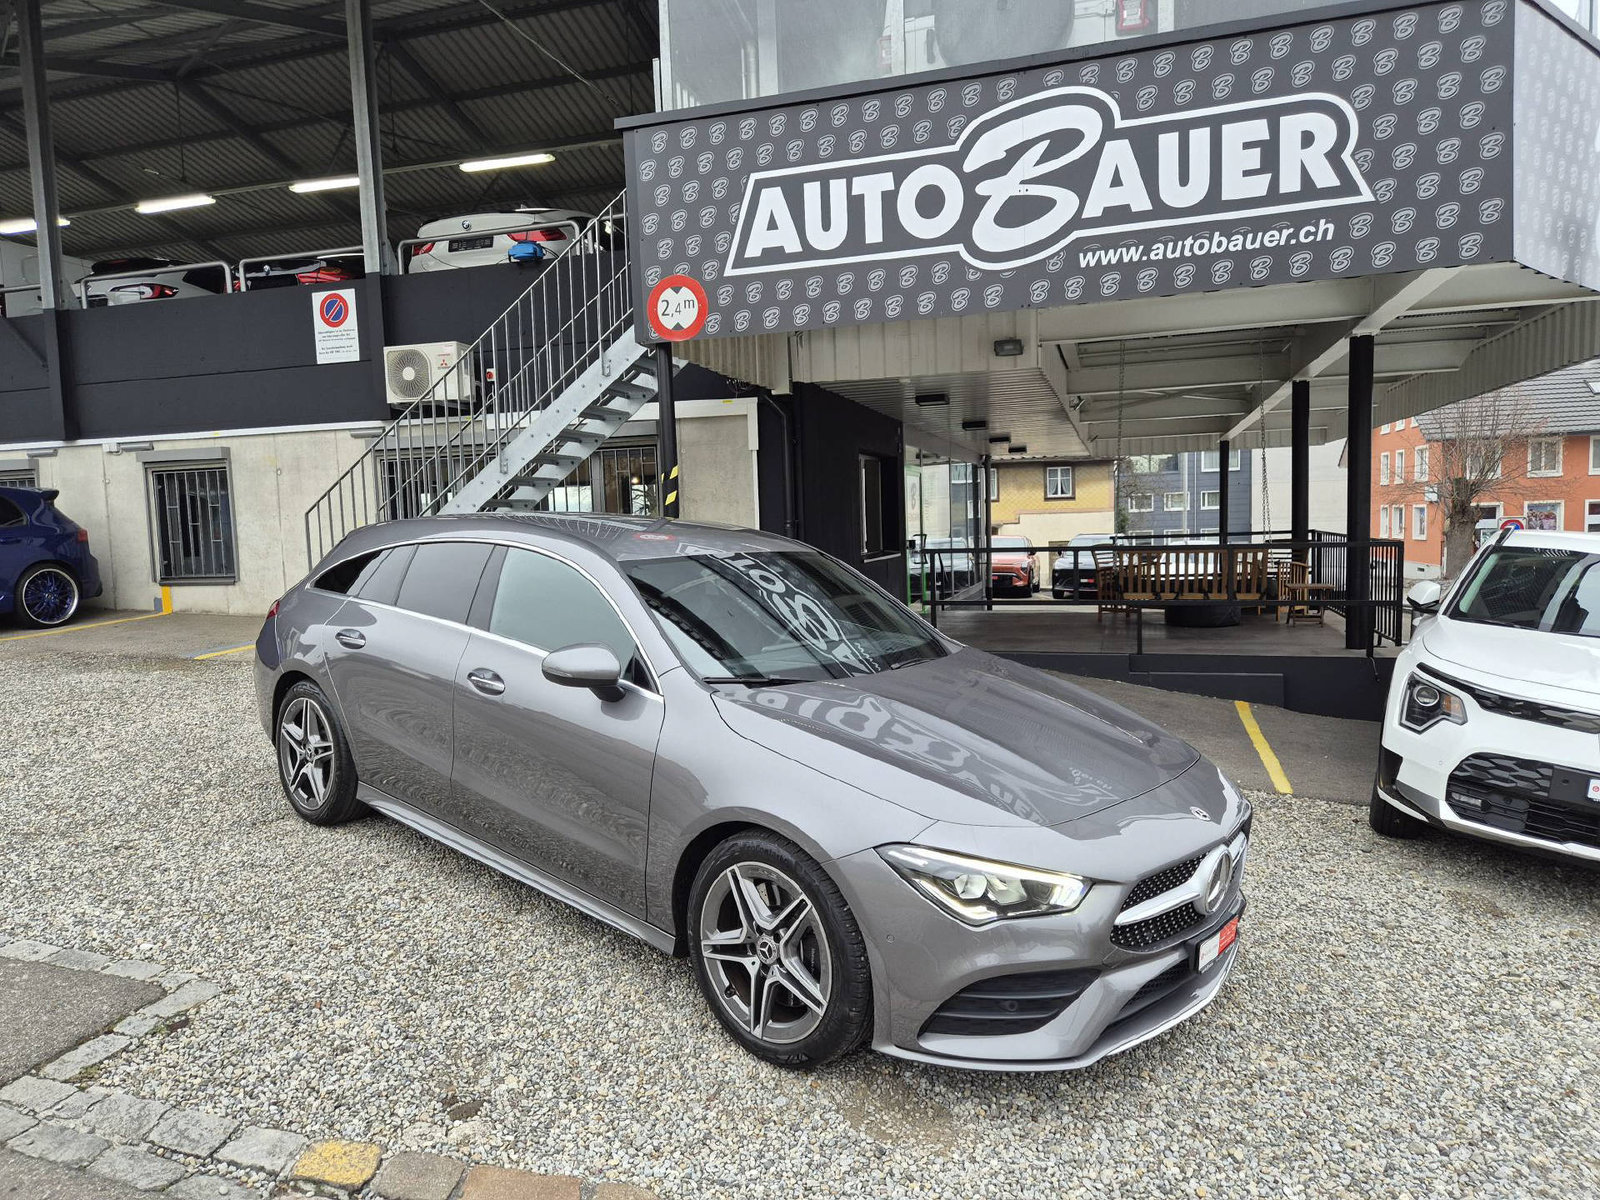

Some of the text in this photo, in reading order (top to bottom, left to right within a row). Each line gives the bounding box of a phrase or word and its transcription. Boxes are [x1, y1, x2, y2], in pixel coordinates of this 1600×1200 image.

[1393, 12, 1419, 40] B
[1437, 6, 1463, 34] B
[1480, 0, 1508, 27] B
[1308, 25, 1334, 53] B
[1351, 19, 1376, 46] B
[1191, 45, 1214, 72] B
[1230, 40, 1254, 65] B
[1269, 33, 1293, 60] B
[1417, 40, 1444, 70] B
[1460, 34, 1487, 63] B
[1116, 58, 1138, 84] B
[1153, 52, 1176, 78] B
[1291, 60, 1315, 88] B
[1331, 54, 1356, 81] B
[1373, 48, 1399, 76] B
[994, 77, 1018, 102] B
[1173, 79, 1196, 105] B
[1211, 73, 1235, 100] B
[1250, 67, 1275, 94] B
[1392, 78, 1418, 105] B
[1437, 71, 1462, 100] B
[1480, 65, 1507, 94] B
[894, 93, 914, 119] B
[927, 88, 948, 113] B
[960, 82, 982, 109] B
[1135, 85, 1158, 111] B
[1351, 84, 1375, 111] B
[799, 108, 820, 133] B
[830, 103, 849, 129] B
[862, 99, 883, 124] B
[1417, 107, 1442, 135] B
[1459, 101, 1485, 129] B
[709, 124, 726, 144] B
[736, 118, 759, 142] B
[769, 113, 787, 136] B
[880, 124, 901, 147] B
[912, 119, 936, 144] B
[947, 115, 965, 139] B
[1372, 113, 1398, 140] B
[652, 131, 668, 153] B
[680, 127, 697, 149] B
[786, 137, 808, 162] B
[816, 133, 838, 159] B
[848, 128, 869, 154] B
[1436, 137, 1462, 164] B
[1479, 132, 1505, 160] B
[697, 152, 714, 173] B
[726, 146, 744, 170] B
[754, 140, 775, 166] B
[1392, 143, 1417, 170] B
[640, 159, 656, 181] B
[668, 156, 684, 178] B
[682, 180, 700, 202] B
[712, 176, 729, 200] B
[1373, 178, 1396, 203] B
[1416, 172, 1441, 200] B
[1459, 167, 1486, 195] B
[654, 184, 671, 206] B
[671, 209, 687, 231] B
[700, 205, 716, 228] B
[1391, 207, 1416, 234] B
[1435, 202, 1461, 229] B
[1479, 198, 1504, 224] B
[642, 213, 659, 235] B
[1349, 212, 1374, 239] B
[657, 238, 674, 260] B
[685, 233, 704, 259] B
[715, 231, 731, 253] B
[1079, 219, 1335, 269] www.autobauer.ch
[1371, 241, 1396, 268] B
[1415, 237, 1440, 263] B
[1458, 232, 1483, 259] B
[701, 257, 722, 283] B
[1211, 259, 1234, 284] B
[1250, 255, 1273, 280] B
[1289, 251, 1313, 277] B
[1329, 246, 1354, 273] B
[645, 266, 661, 287] B
[835, 272, 856, 295] B
[867, 267, 888, 294] B
[897, 264, 919, 288] B
[931, 261, 952, 285] B
[1100, 271, 1121, 296] B
[1136, 267, 1159, 292] B
[1173, 263, 1196, 288] B
[717, 284, 734, 306] B
[745, 281, 763, 308] B
[775, 277, 794, 302] B
[805, 275, 824, 298] B
[951, 287, 970, 311] B
[983, 284, 1004, 308] B
[1030, 279, 1050, 303] B
[1064, 275, 1086, 300] B
[792, 303, 812, 327] B
[822, 300, 841, 323] B
[854, 298, 872, 320] B
[884, 294, 904, 318] B
[917, 291, 936, 315] B
[705, 312, 722, 334] B
[734, 308, 751, 332] B
[762, 305, 780, 329] B
